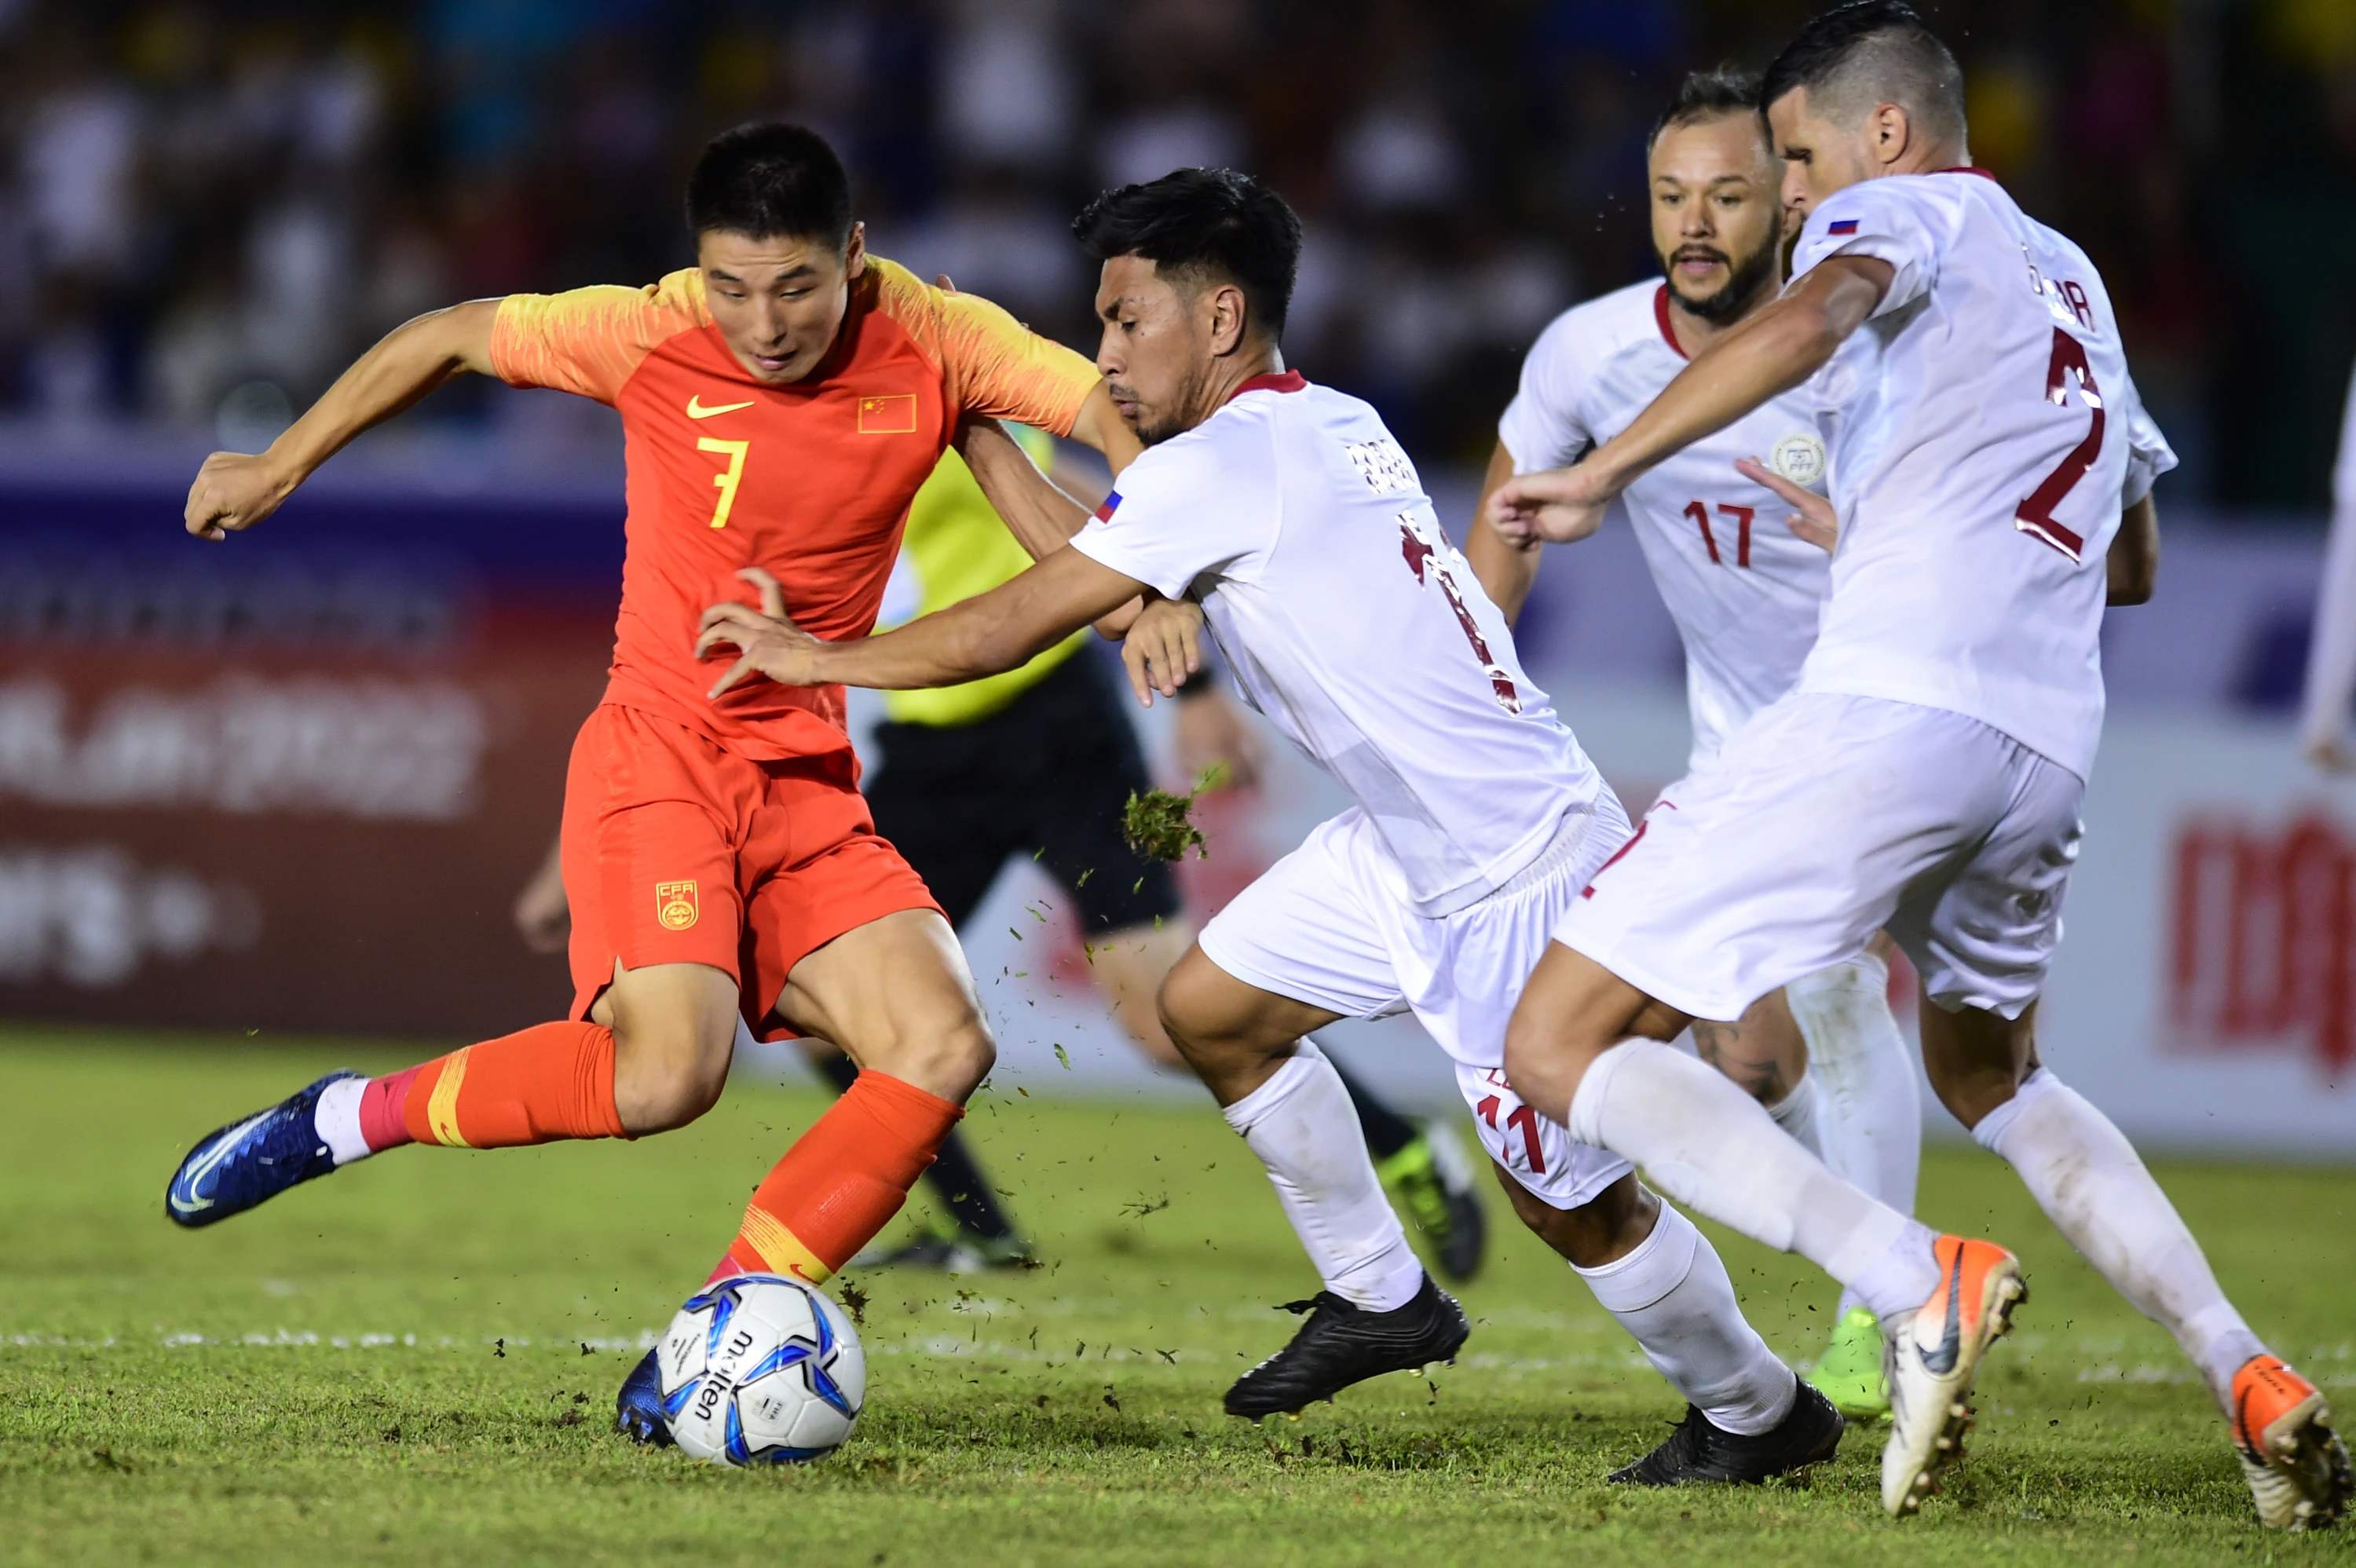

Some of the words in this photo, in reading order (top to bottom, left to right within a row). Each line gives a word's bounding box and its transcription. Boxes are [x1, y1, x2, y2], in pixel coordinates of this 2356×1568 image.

[697, 437, 750, 528] 7
[2014, 325, 2105, 566] 2
[1683, 499, 1755, 569] 17
[1395, 509, 1522, 718] 1
[660, 883, 693, 897] CFA
[1477, 1094, 1546, 1175] 11
[694, 1330, 753, 1421] molten
